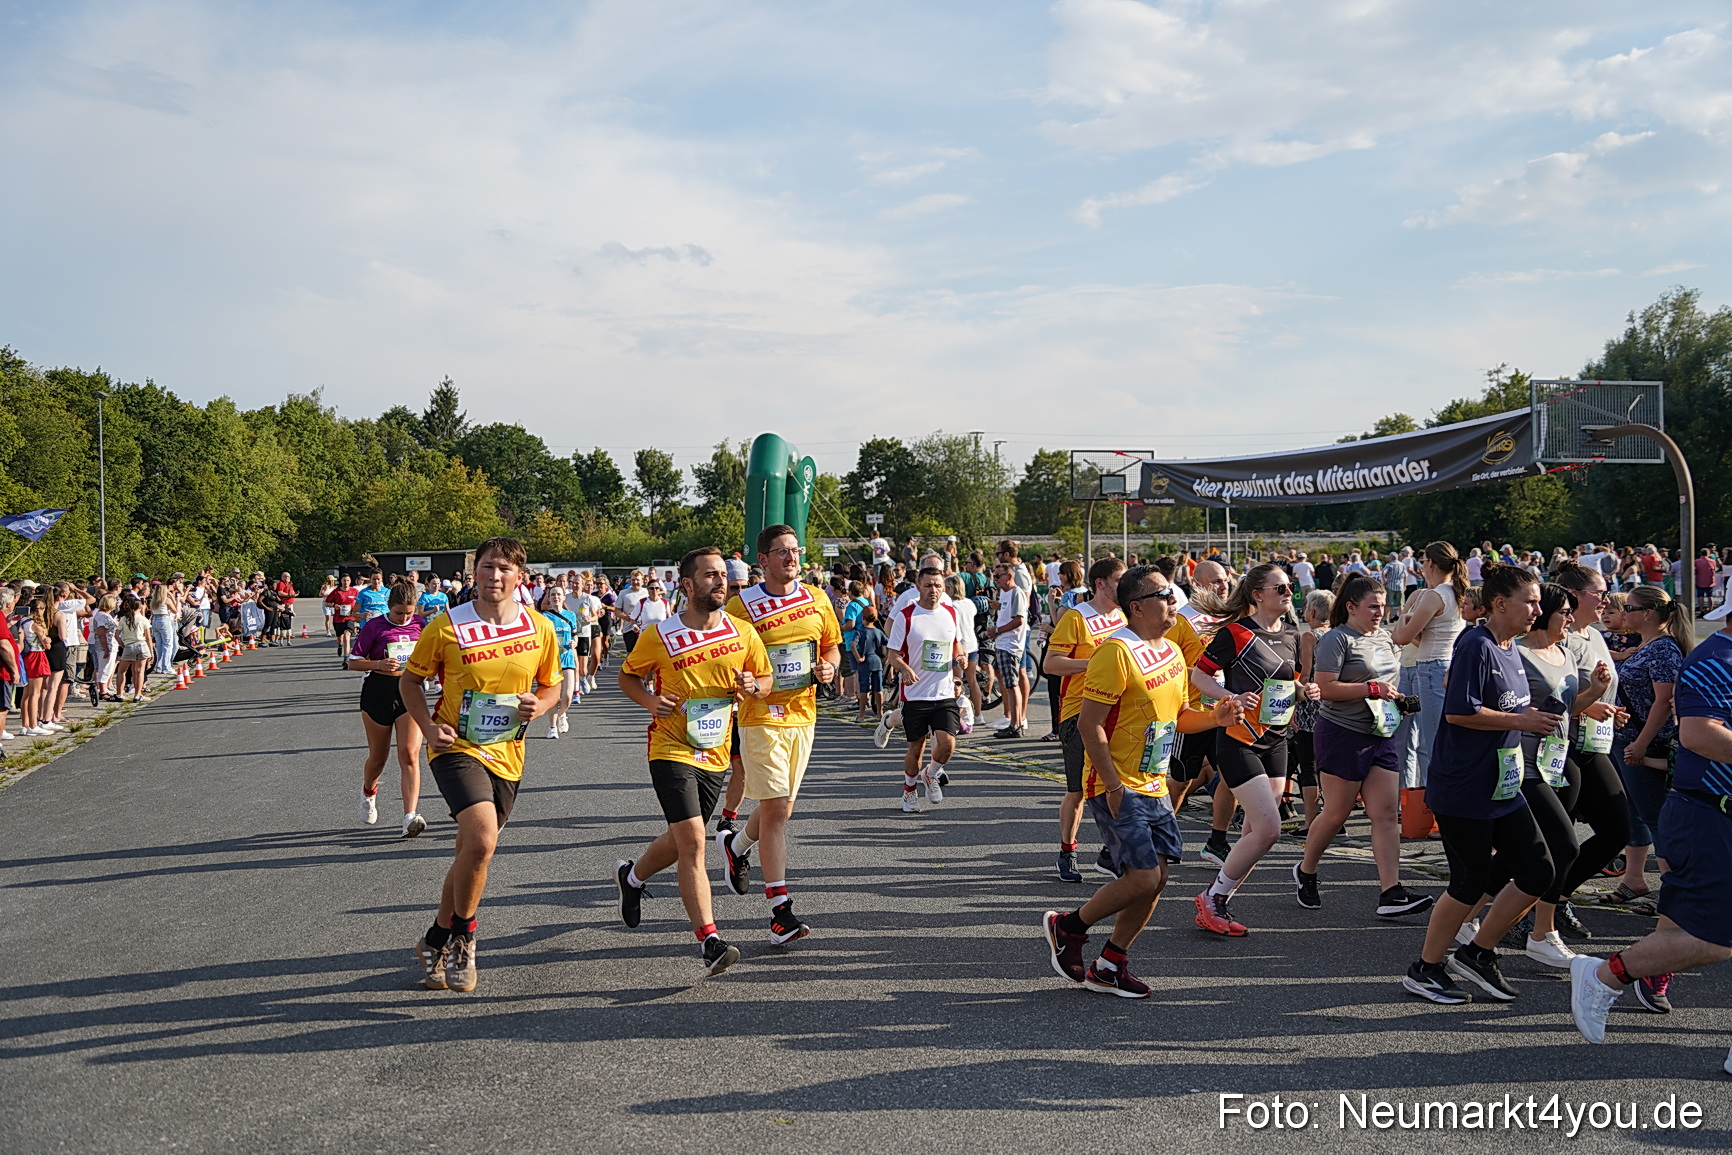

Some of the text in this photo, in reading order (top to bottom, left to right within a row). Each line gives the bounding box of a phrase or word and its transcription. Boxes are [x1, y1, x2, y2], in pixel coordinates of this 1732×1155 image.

[1192, 456, 1438, 504] Hier gewinnt das Miteinander.
[1471, 473, 1481, 482] Ein
[1480, 472, 1491, 480] Ort,
[1490, 470, 1500, 479] der
[755, 606, 819, 635] MAX BÖGL
[461, 640, 540, 665] MAX BÖGL
[672, 642, 744, 672] MAX BÖGL
[930, 652, 944, 660] 577
[776, 661, 802, 673] 1733
[1145, 672, 1169, 691] MAX
[1268, 698, 1291, 709] 2469
[480, 714, 510, 726] 1763
[696, 718, 722, 730] 1590
[1596, 725, 1611, 736] 802
[1551, 757, 1564, 770] 80
